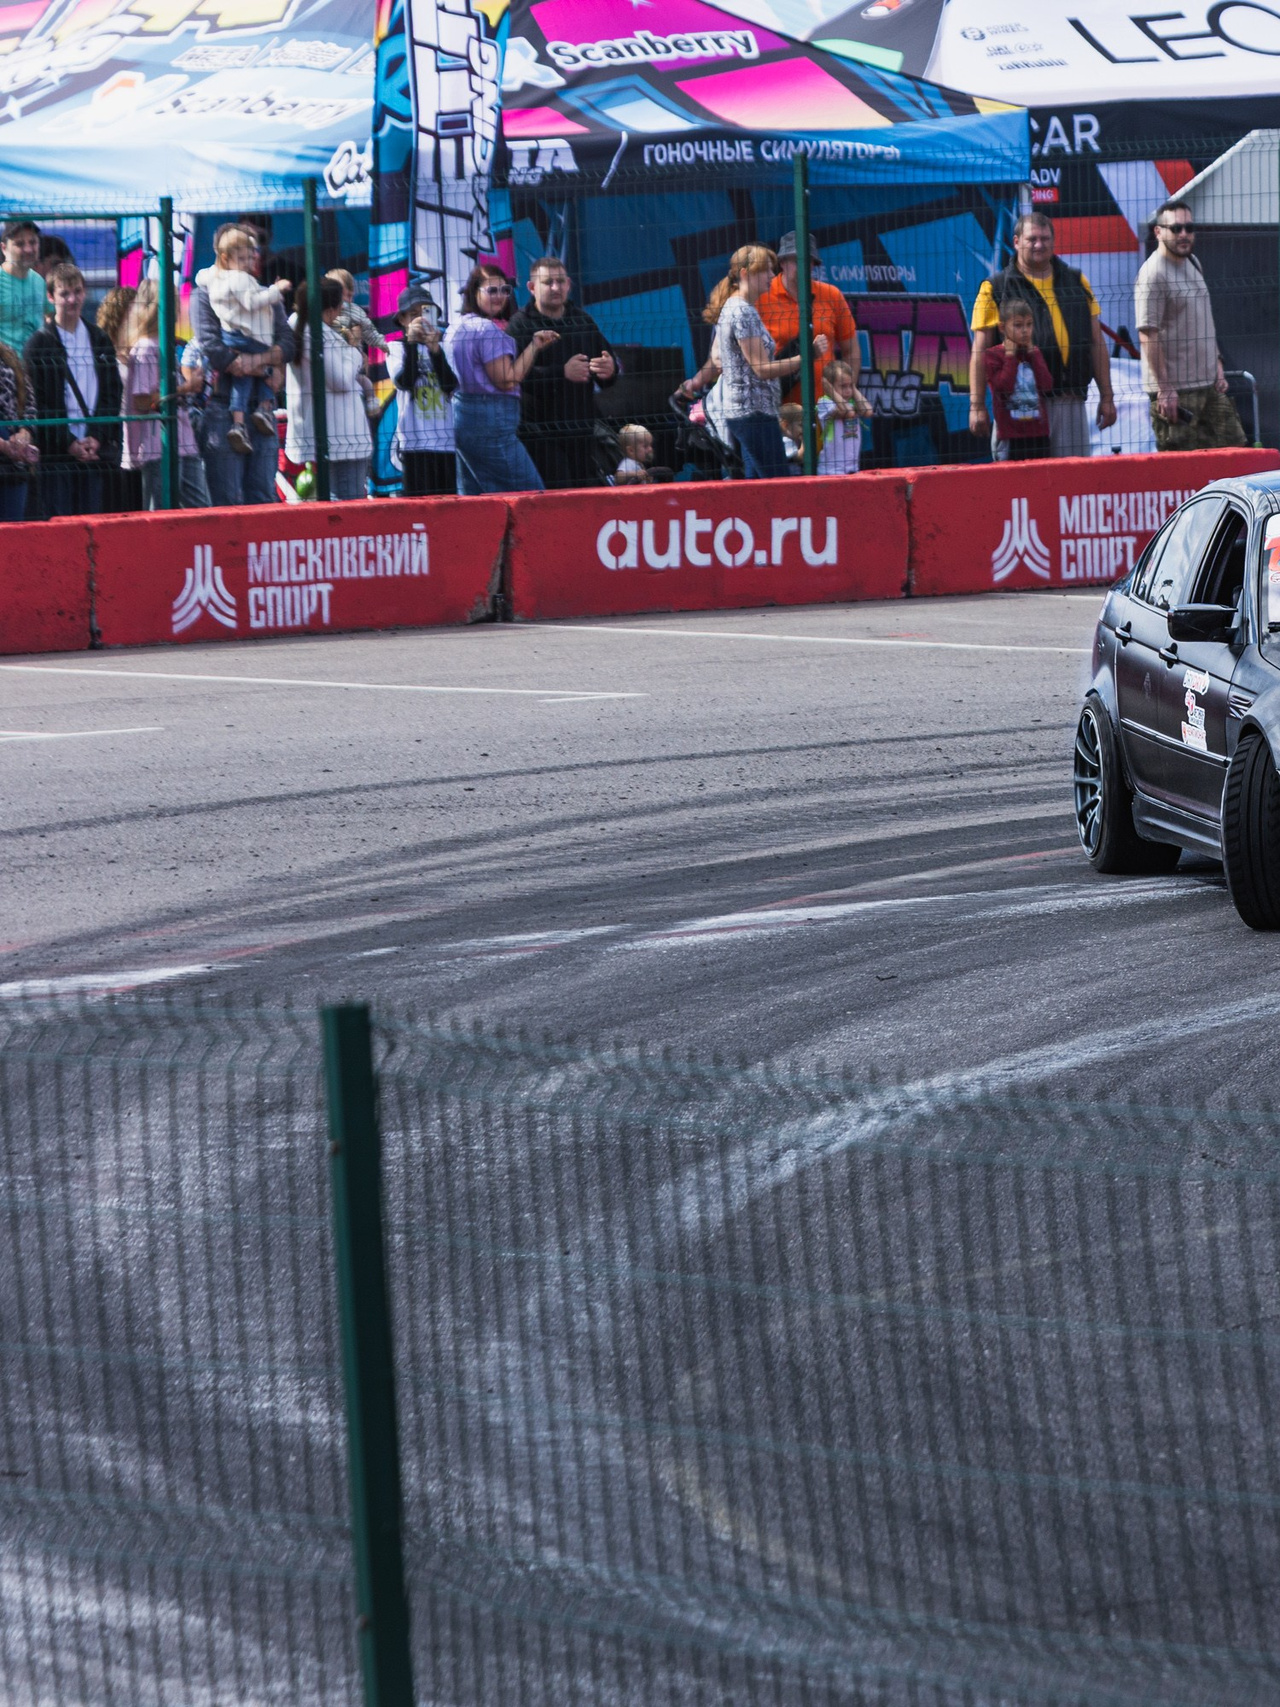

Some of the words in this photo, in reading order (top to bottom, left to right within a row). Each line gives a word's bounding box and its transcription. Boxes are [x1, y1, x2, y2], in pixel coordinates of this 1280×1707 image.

[550, 31, 757, 69] Scanberry
[643, 139, 754, 166] ГОНОЧНЫЕ
[830, 265, 917, 283] СИМУЛЯТОРЫ
[1058, 489, 1197, 534] МОСКОВС
[247, 523, 430, 584] МОСКОВСКИЙ
[596, 509, 838, 571] auto.ru
[1060, 535, 1137, 580] СПОРТ
[247, 583, 334, 629] СПОРТ
